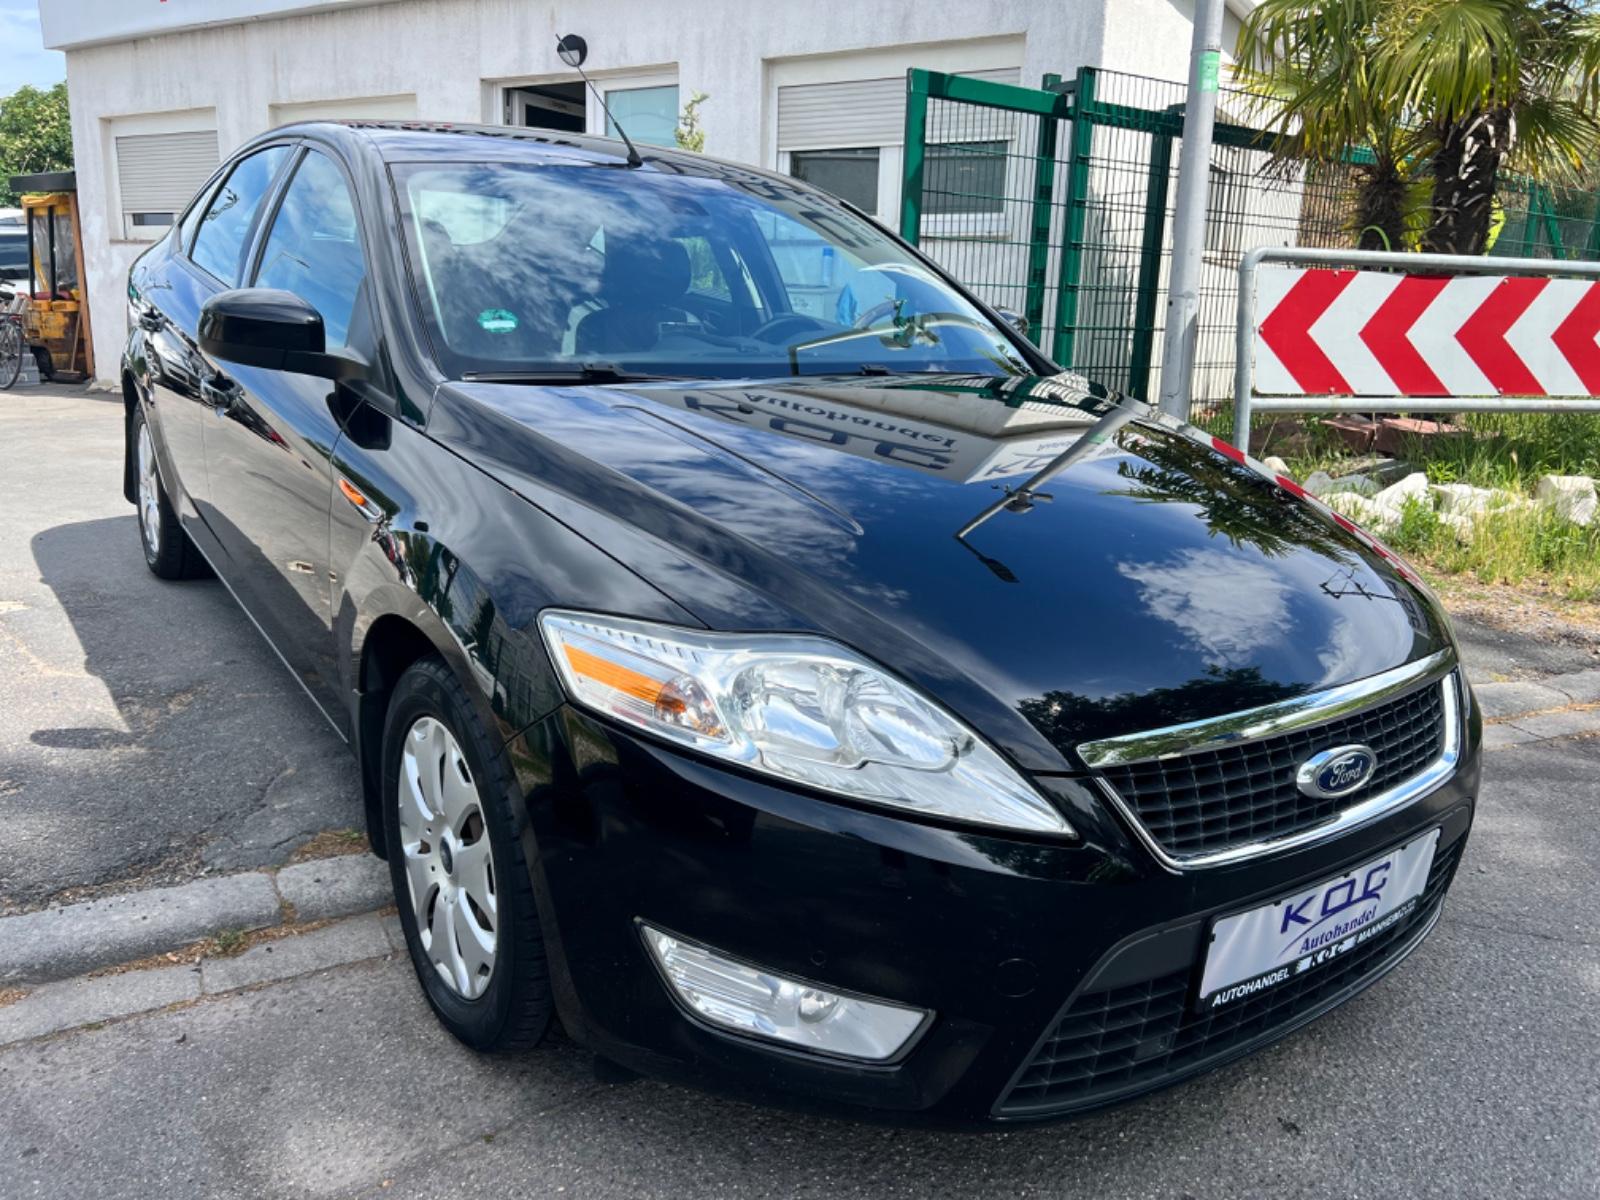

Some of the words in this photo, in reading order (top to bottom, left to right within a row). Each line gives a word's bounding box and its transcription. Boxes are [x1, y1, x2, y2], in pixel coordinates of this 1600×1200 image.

[1329, 757, 1363, 787] Ford
[1299, 905, 1377, 954] Autohandel
[1212, 967, 1290, 1007] AUTOHANDEL
